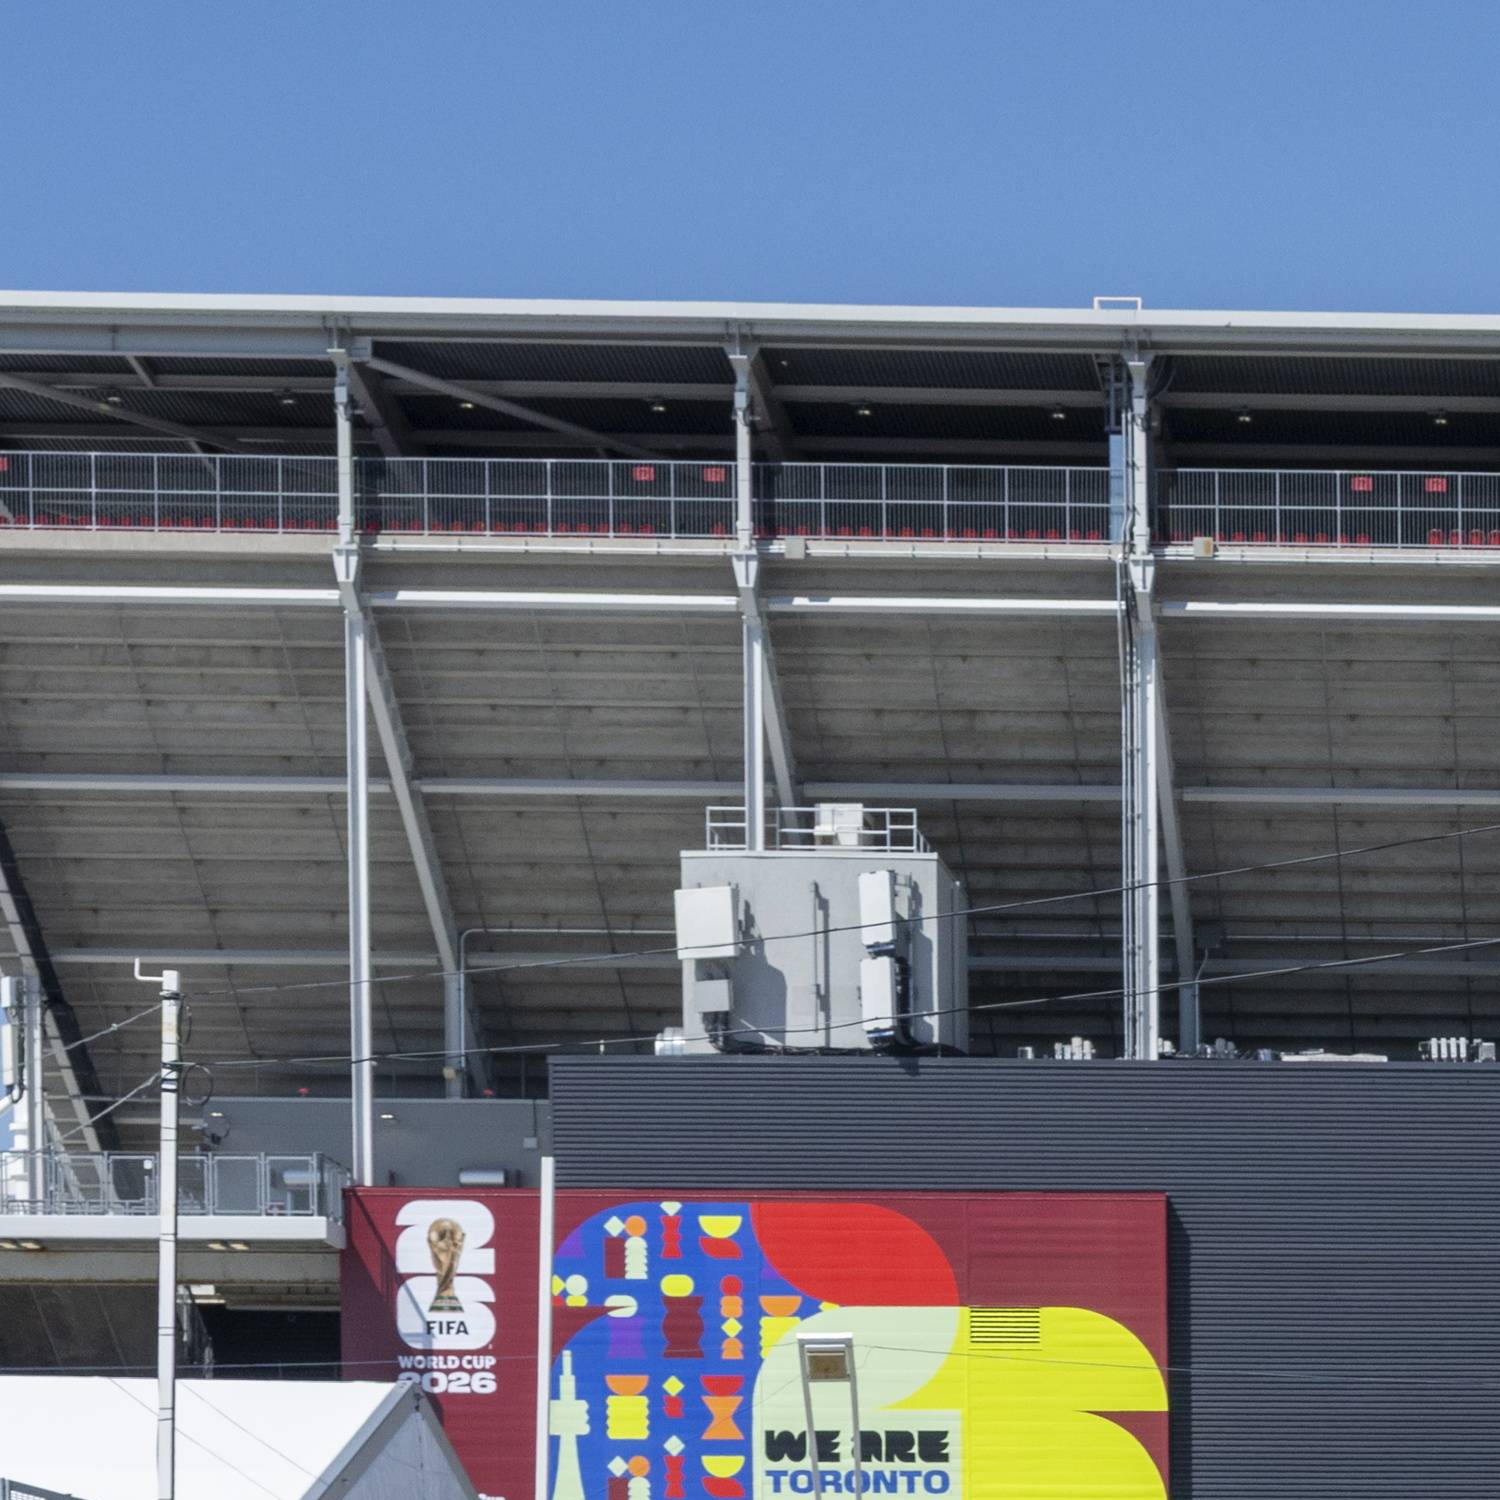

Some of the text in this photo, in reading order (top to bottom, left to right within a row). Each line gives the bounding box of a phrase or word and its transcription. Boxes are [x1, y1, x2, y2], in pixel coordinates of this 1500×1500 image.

[426, 1320, 469, 1336] FIFA
[398, 1355, 497, 1369] WORLD CUP
[765, 1430, 841, 1462] WE
[765, 1469, 950, 1494] TORONTO
